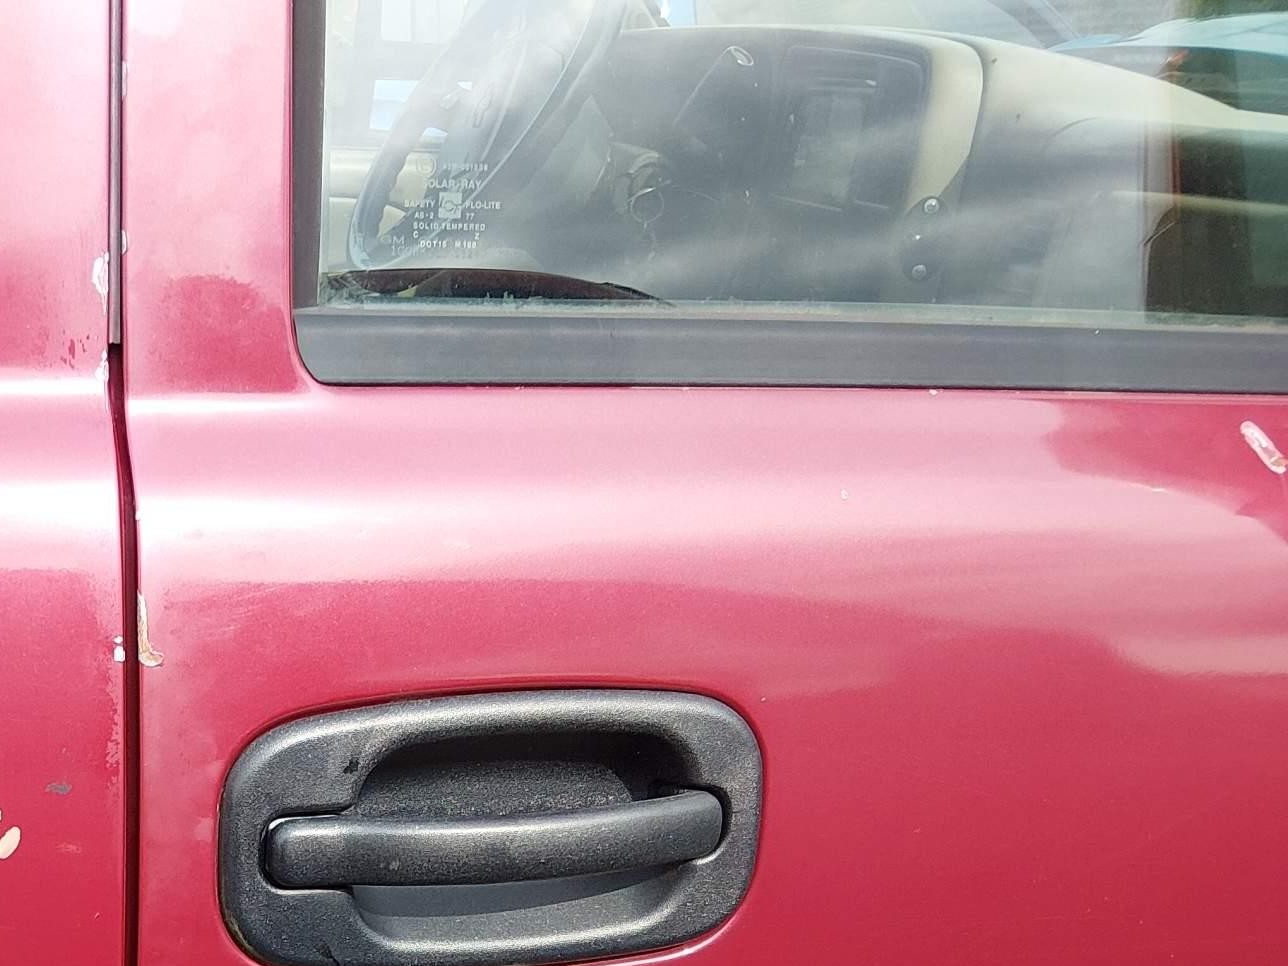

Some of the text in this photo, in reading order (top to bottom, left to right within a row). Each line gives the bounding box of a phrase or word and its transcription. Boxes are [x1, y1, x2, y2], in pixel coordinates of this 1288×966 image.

[404, 199, 501, 210] SAFETY FLO-LITE
[413, 221, 486, 232] SOLID TEMPERED
